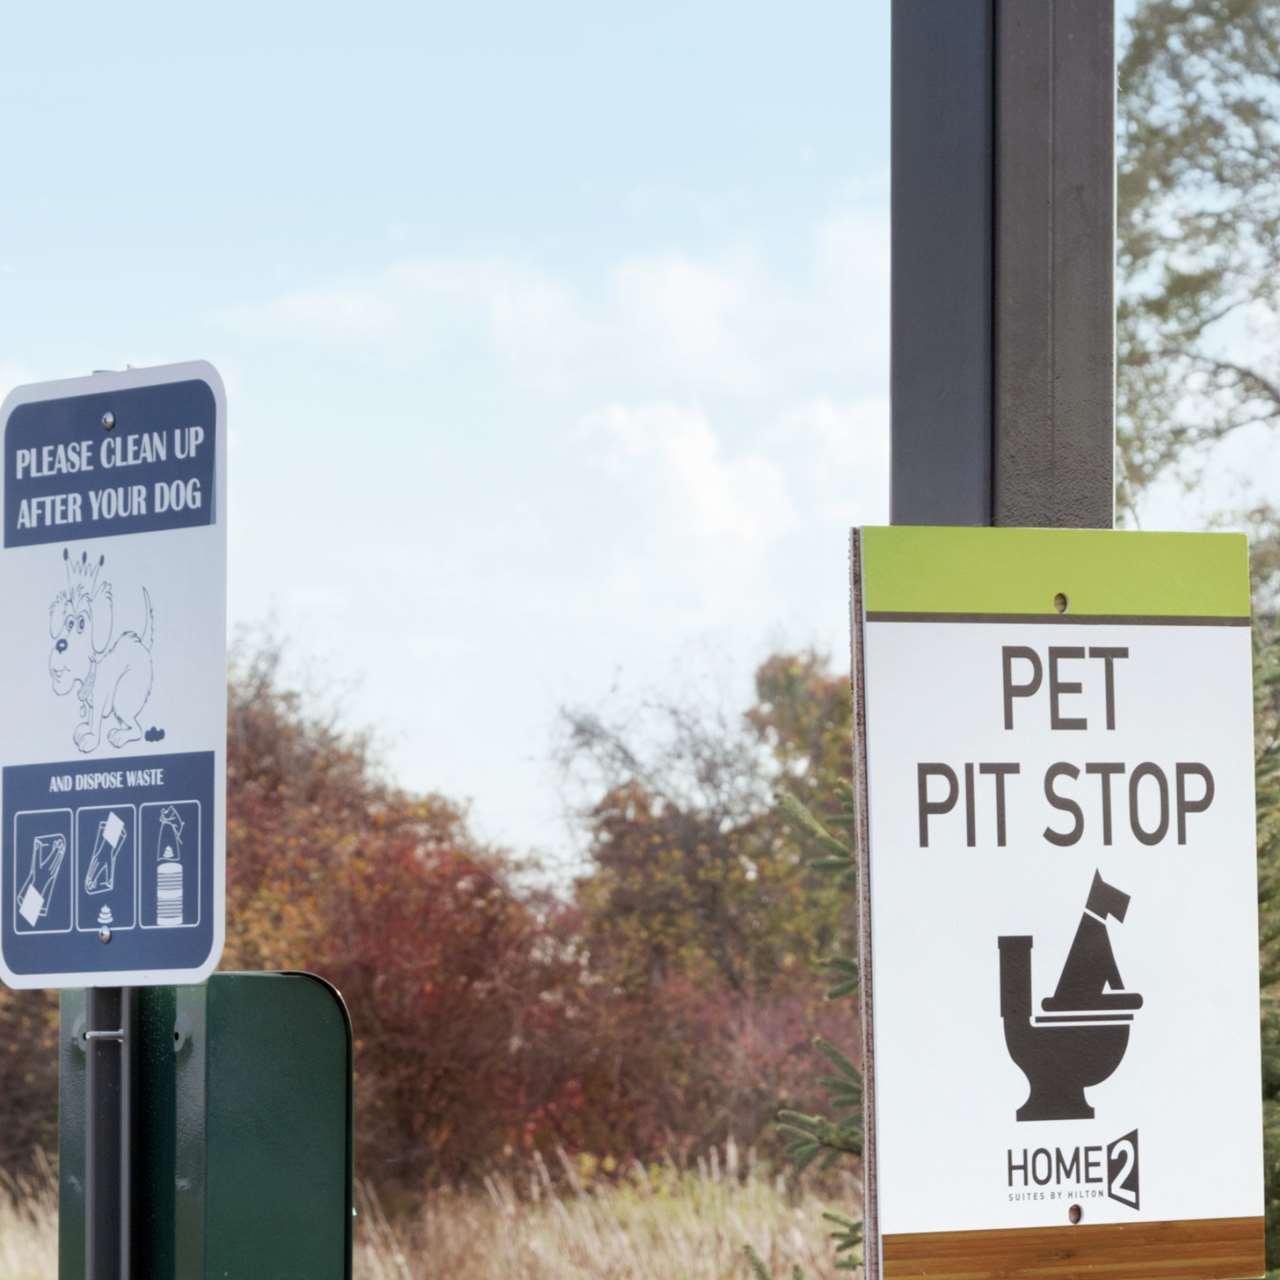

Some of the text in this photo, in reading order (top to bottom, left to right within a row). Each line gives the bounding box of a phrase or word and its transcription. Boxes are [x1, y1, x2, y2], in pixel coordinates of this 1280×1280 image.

[16, 426, 205, 479] PLEASE CLEAN UP
[17, 477, 202, 528] AFTER YOUR DOG
[1001, 646, 1129, 730] PET
[49, 769, 164, 792] AND DISPOSE WASTE
[917, 761, 1216, 848] PIT STOP
[1008, 1189, 1104, 1202] SUITES BY HILTON
